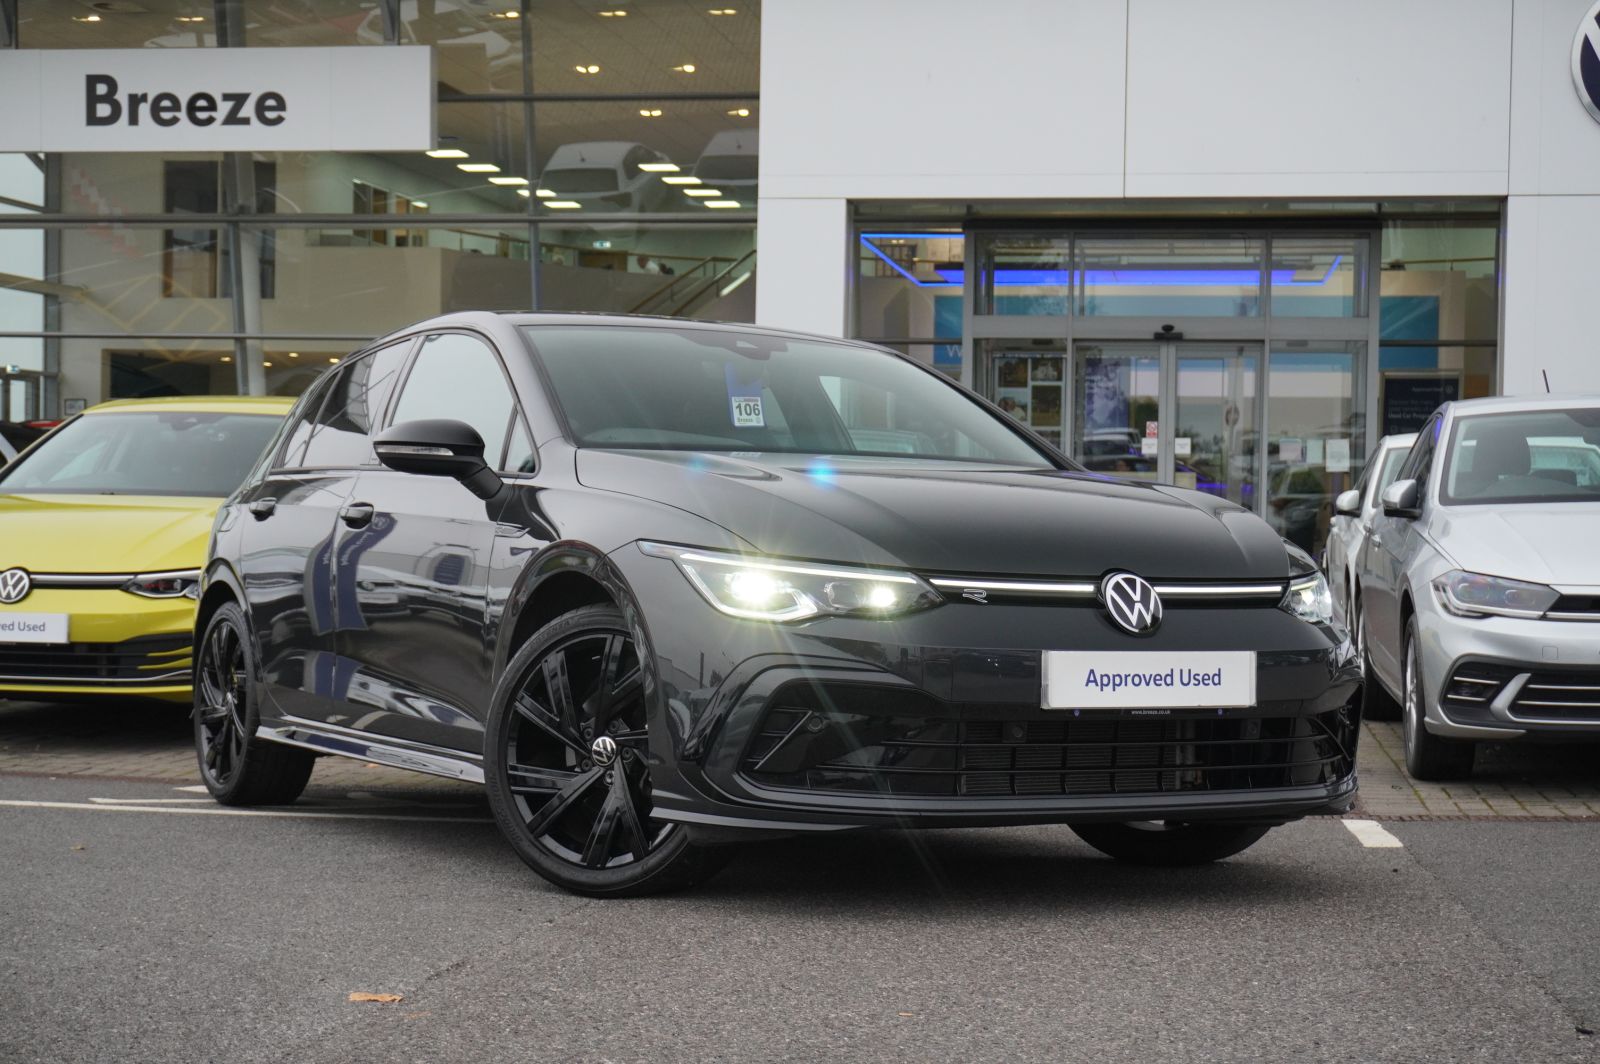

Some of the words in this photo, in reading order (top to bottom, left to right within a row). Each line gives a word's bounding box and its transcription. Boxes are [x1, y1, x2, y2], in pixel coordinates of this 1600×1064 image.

[85, 74, 287, 127] Breeze
[735, 403, 761, 416] 106
[17, 621, 46, 632] Used
[1085, 668, 1174, 692] Approved
[1179, 668, 1222, 687] Used
